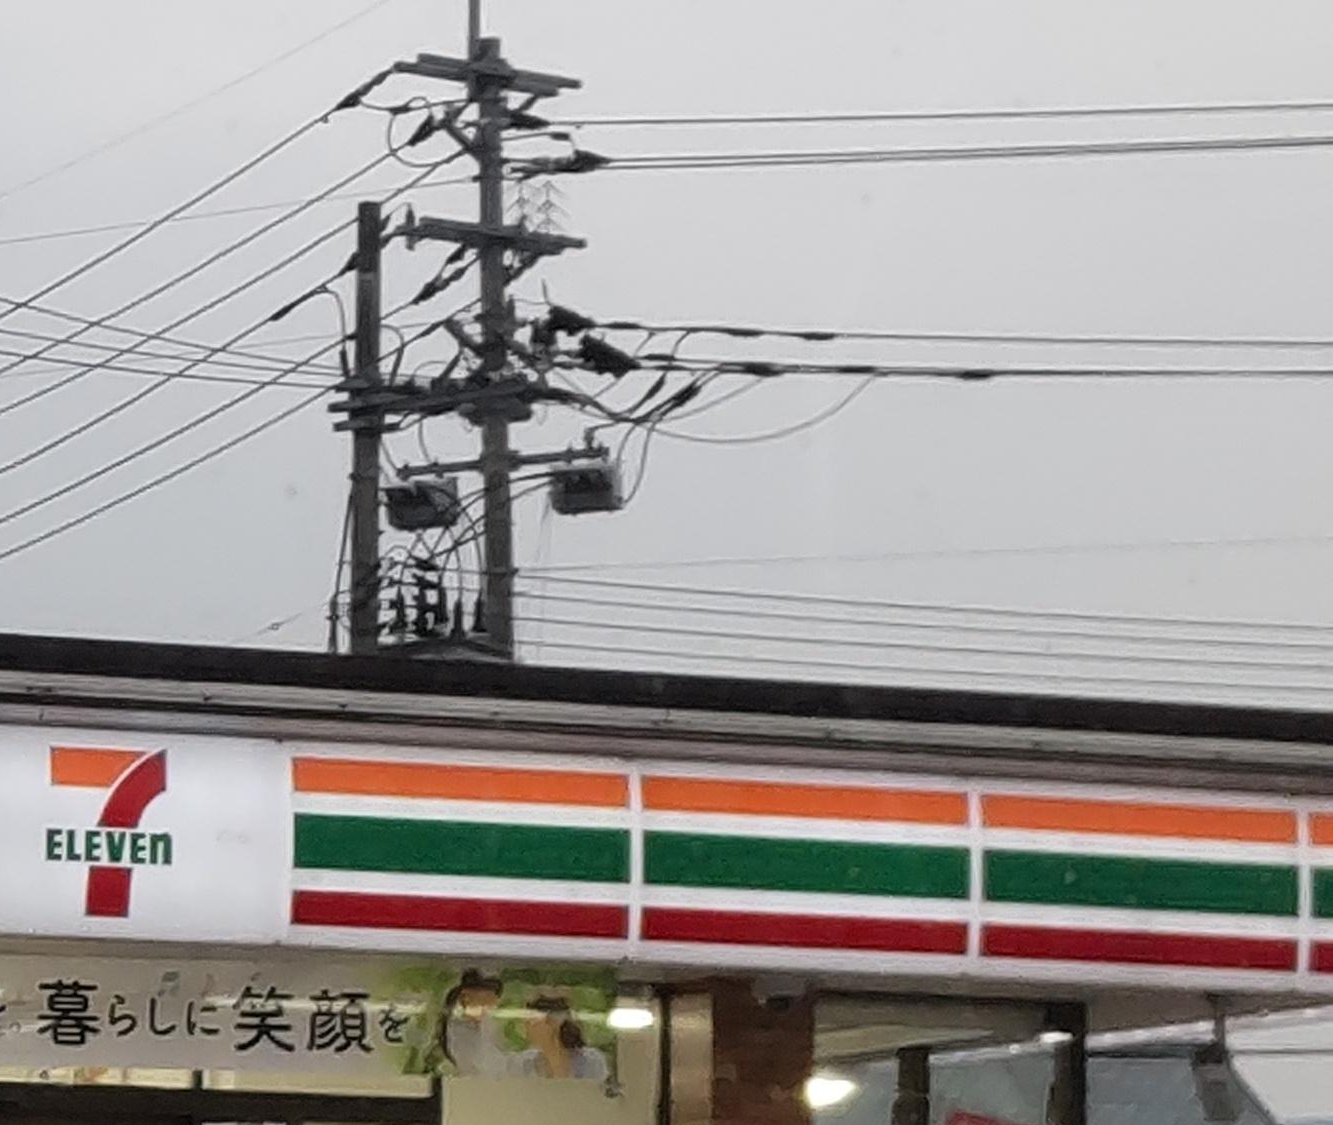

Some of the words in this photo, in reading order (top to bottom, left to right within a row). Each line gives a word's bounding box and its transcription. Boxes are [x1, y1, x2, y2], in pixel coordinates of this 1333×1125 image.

[49, 746, 167, 918] 7
[35, 979, 410, 1054] 暮らしに笑顔を
